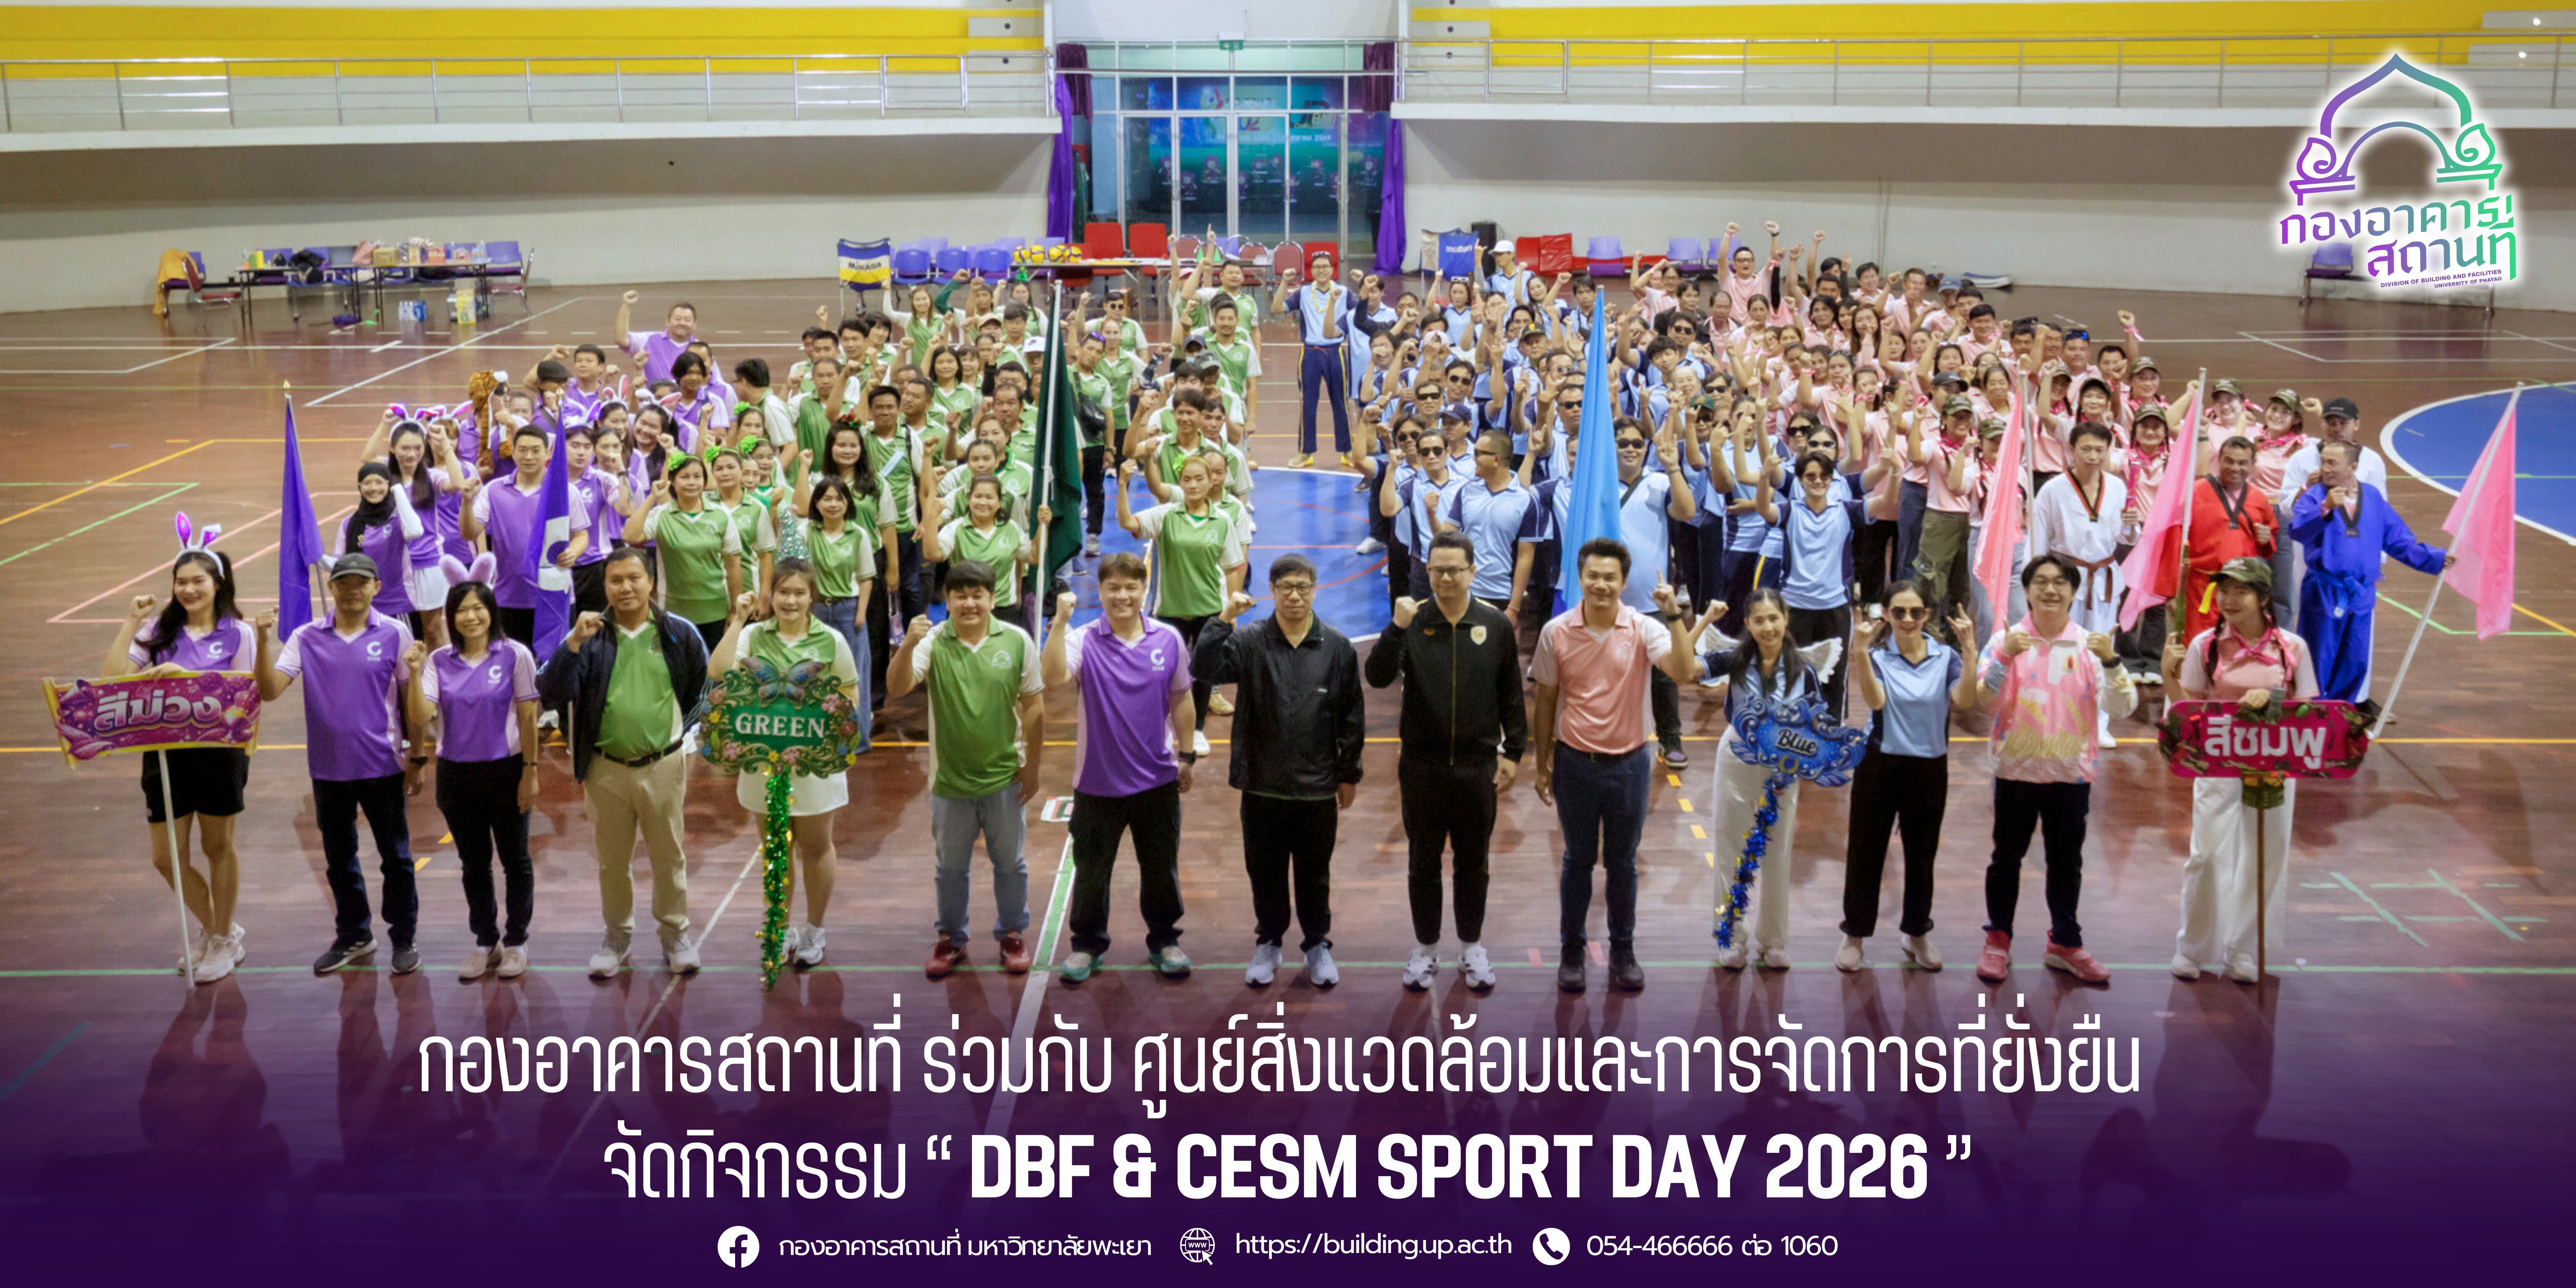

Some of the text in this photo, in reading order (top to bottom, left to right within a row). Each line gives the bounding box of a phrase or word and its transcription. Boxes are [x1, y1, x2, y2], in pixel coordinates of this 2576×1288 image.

[94, 690, 222, 731] สีม่วง
[735, 714, 825, 738] GREEN
[1777, 727, 1816, 754] Blue
[2205, 714, 2326, 770] สีชมพู
